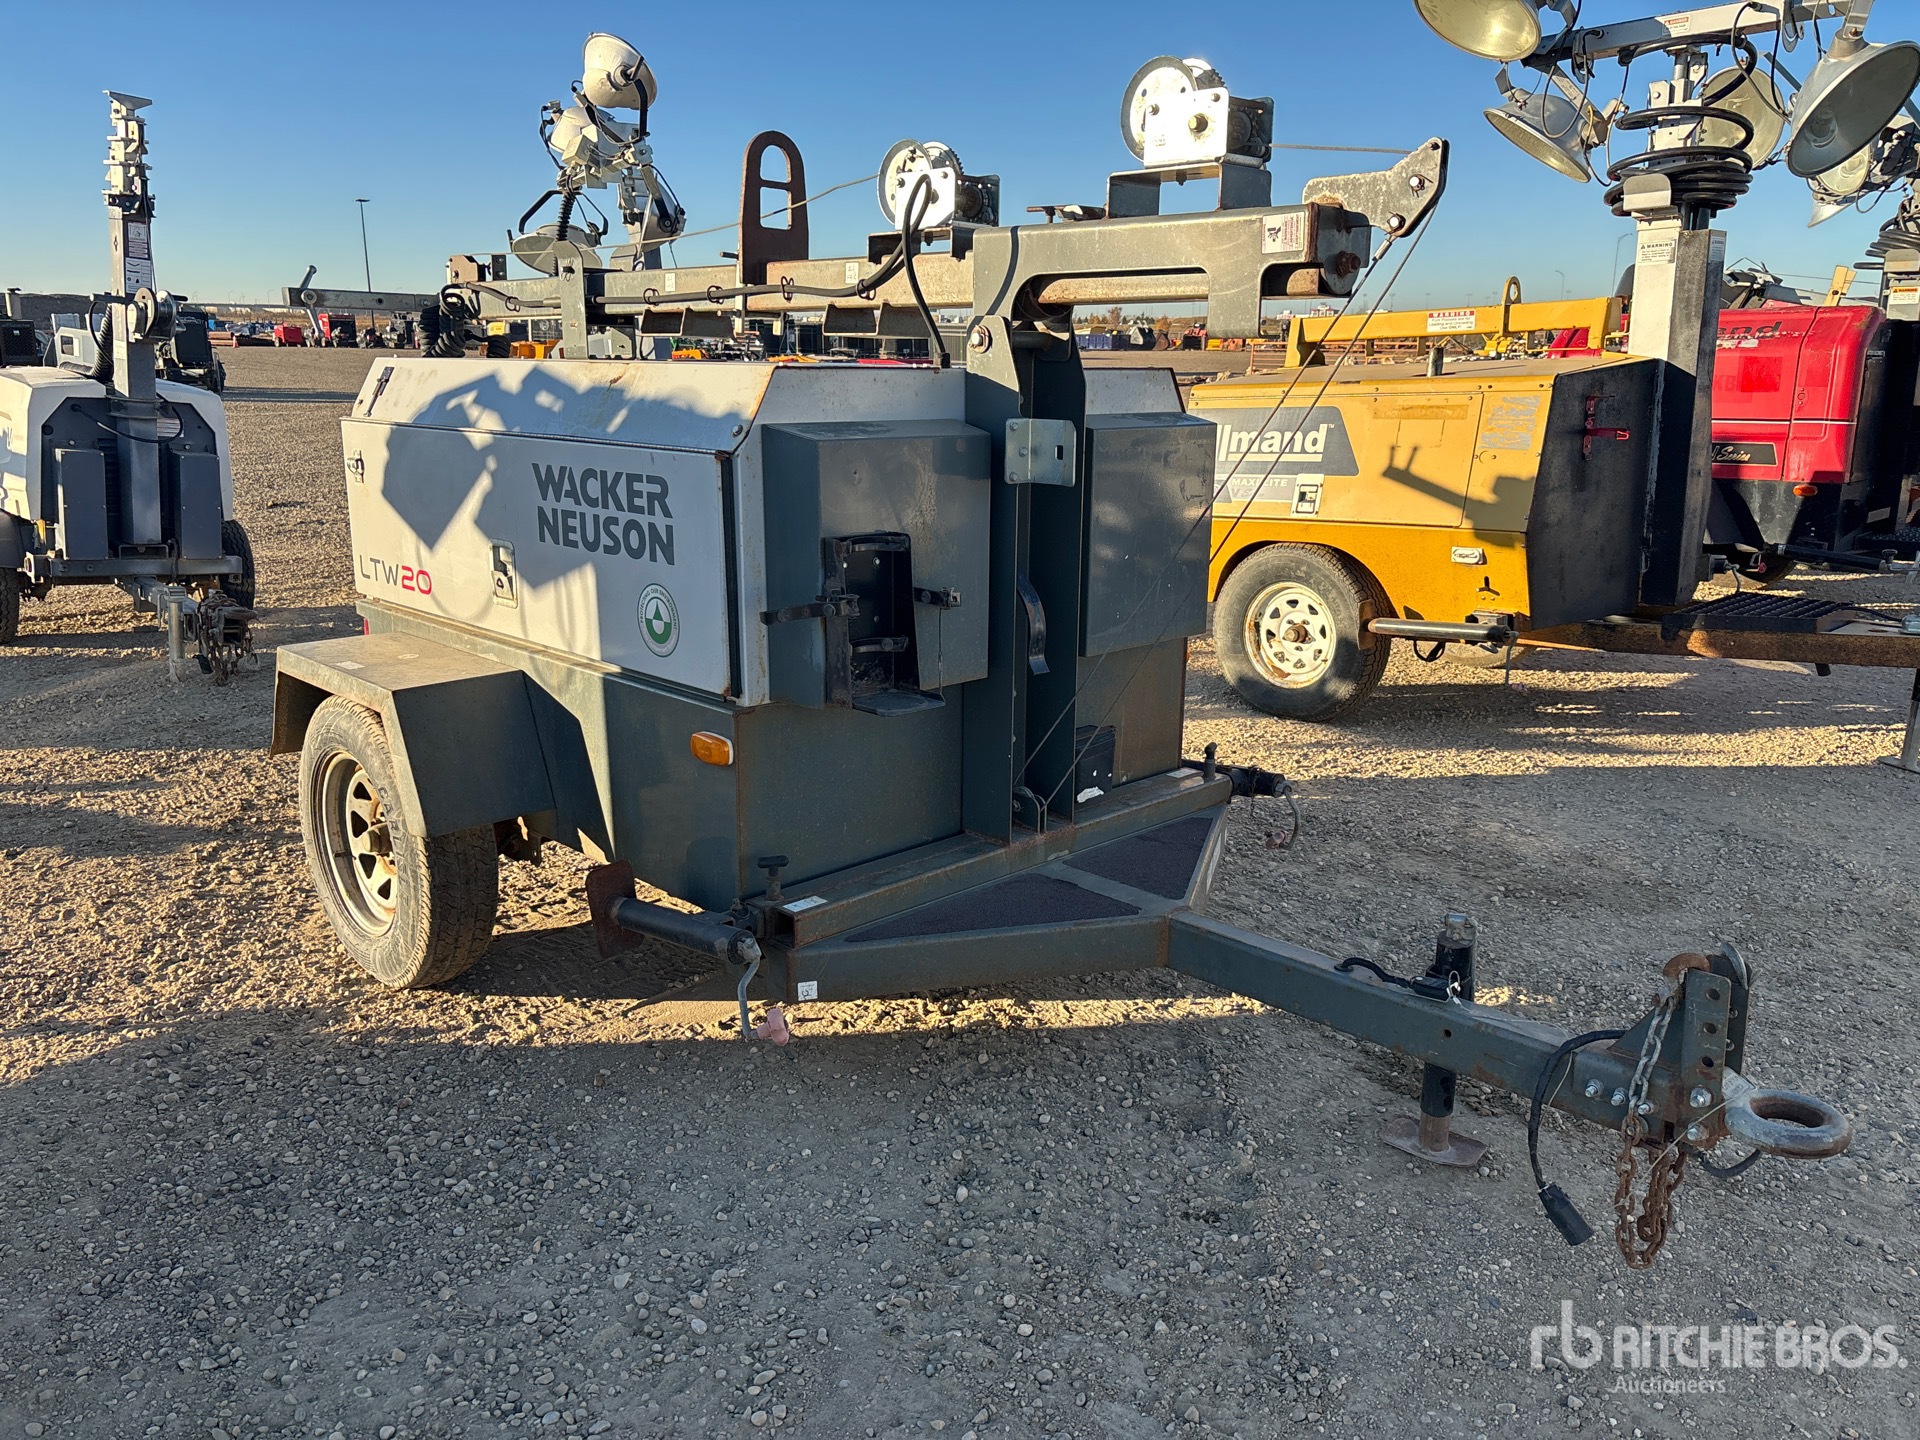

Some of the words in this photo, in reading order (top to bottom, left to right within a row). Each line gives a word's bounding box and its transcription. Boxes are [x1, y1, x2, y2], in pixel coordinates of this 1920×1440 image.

[1216, 424, 1328, 461] llmand
[531, 462, 673, 519] WACKER
[537, 505, 675, 566] NEUSON
[359, 554, 433, 595] LTW20
